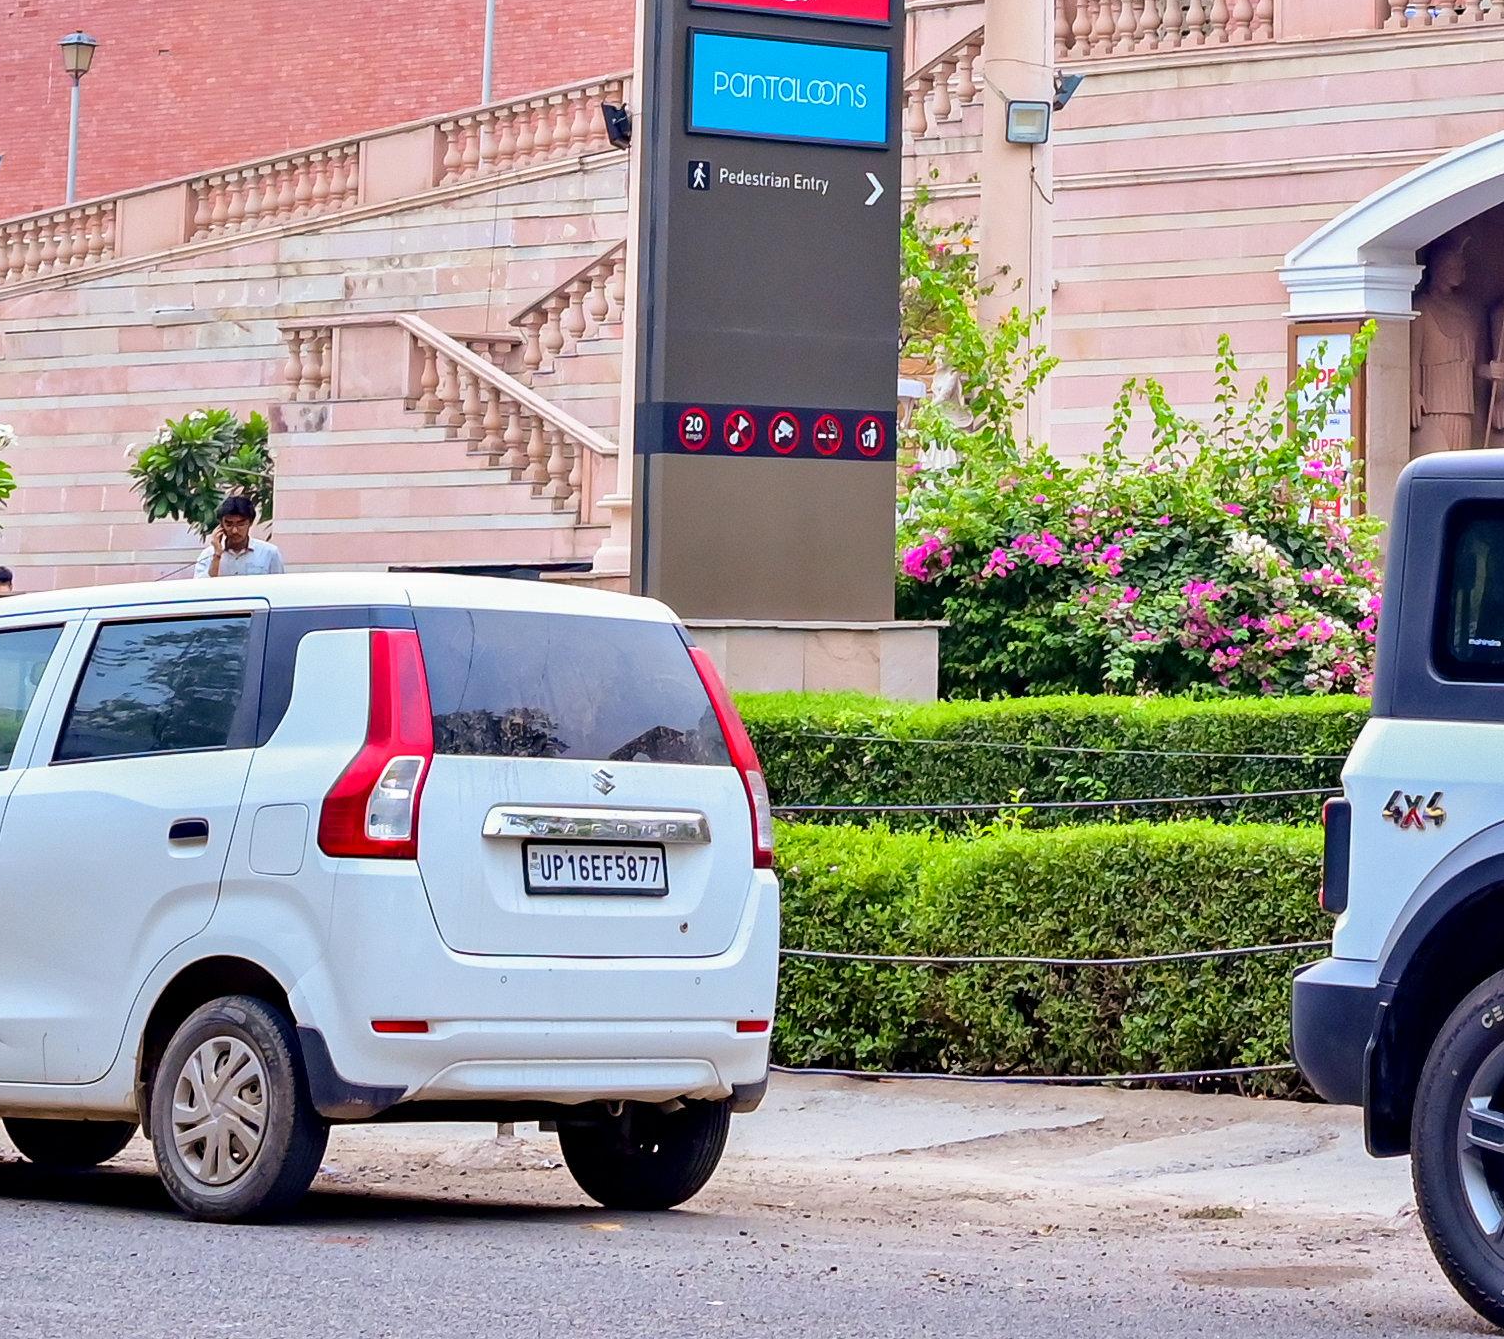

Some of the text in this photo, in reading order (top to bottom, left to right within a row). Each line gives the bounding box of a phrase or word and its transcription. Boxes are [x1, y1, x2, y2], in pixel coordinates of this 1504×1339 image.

[718, 167, 829, 196] Pedestrian Entry
[685, 415, 704, 432] 20
[539, 852, 661, 883] UP16EF5877
